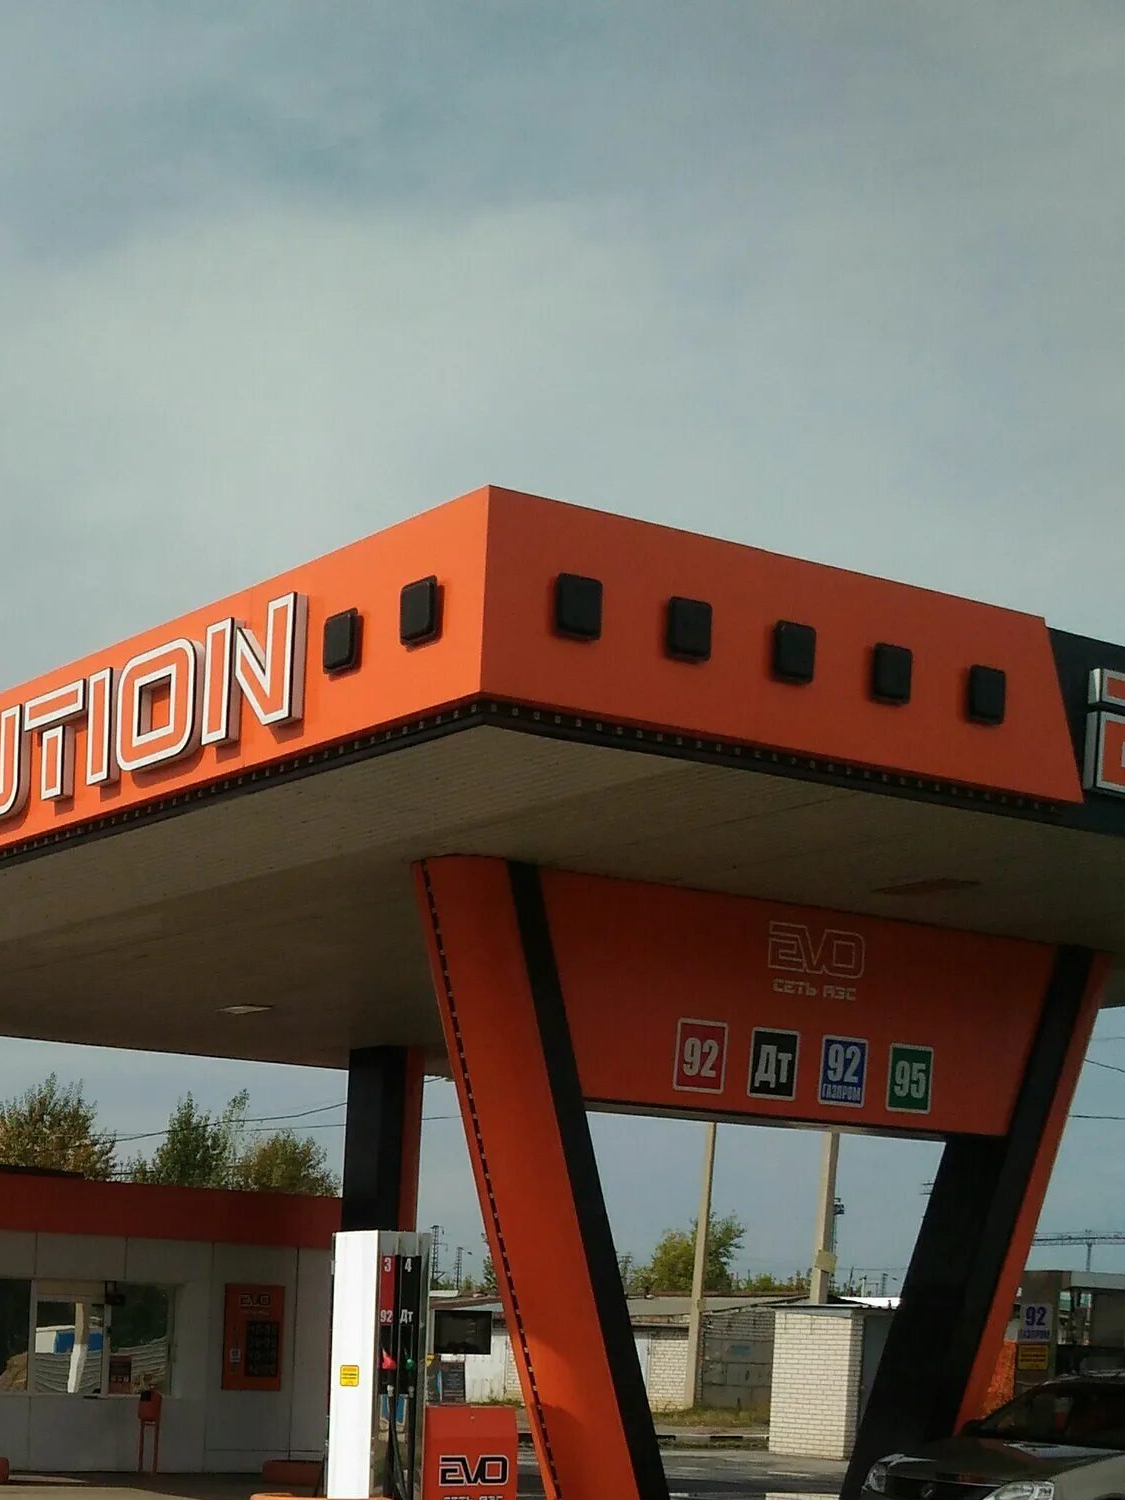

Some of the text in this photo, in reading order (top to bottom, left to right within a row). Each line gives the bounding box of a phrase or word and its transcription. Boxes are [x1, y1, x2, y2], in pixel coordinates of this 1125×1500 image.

[768, 920, 865, 979] EVO
[773, 979, 856, 1001] СЕТЬ АЗС
[683, 1037, 719, 1078] 92
[827, 1043, 859, 1083] 92
[894, 1060, 925, 1099] 95
[384, 1257, 392, 1272] 3
[404, 1258, 412, 1273] 4
[380, 1309, 393, 1323] 92
[1025, 1306, 1047, 1326] 92
[439, 1455, 509, 1487] EVO
